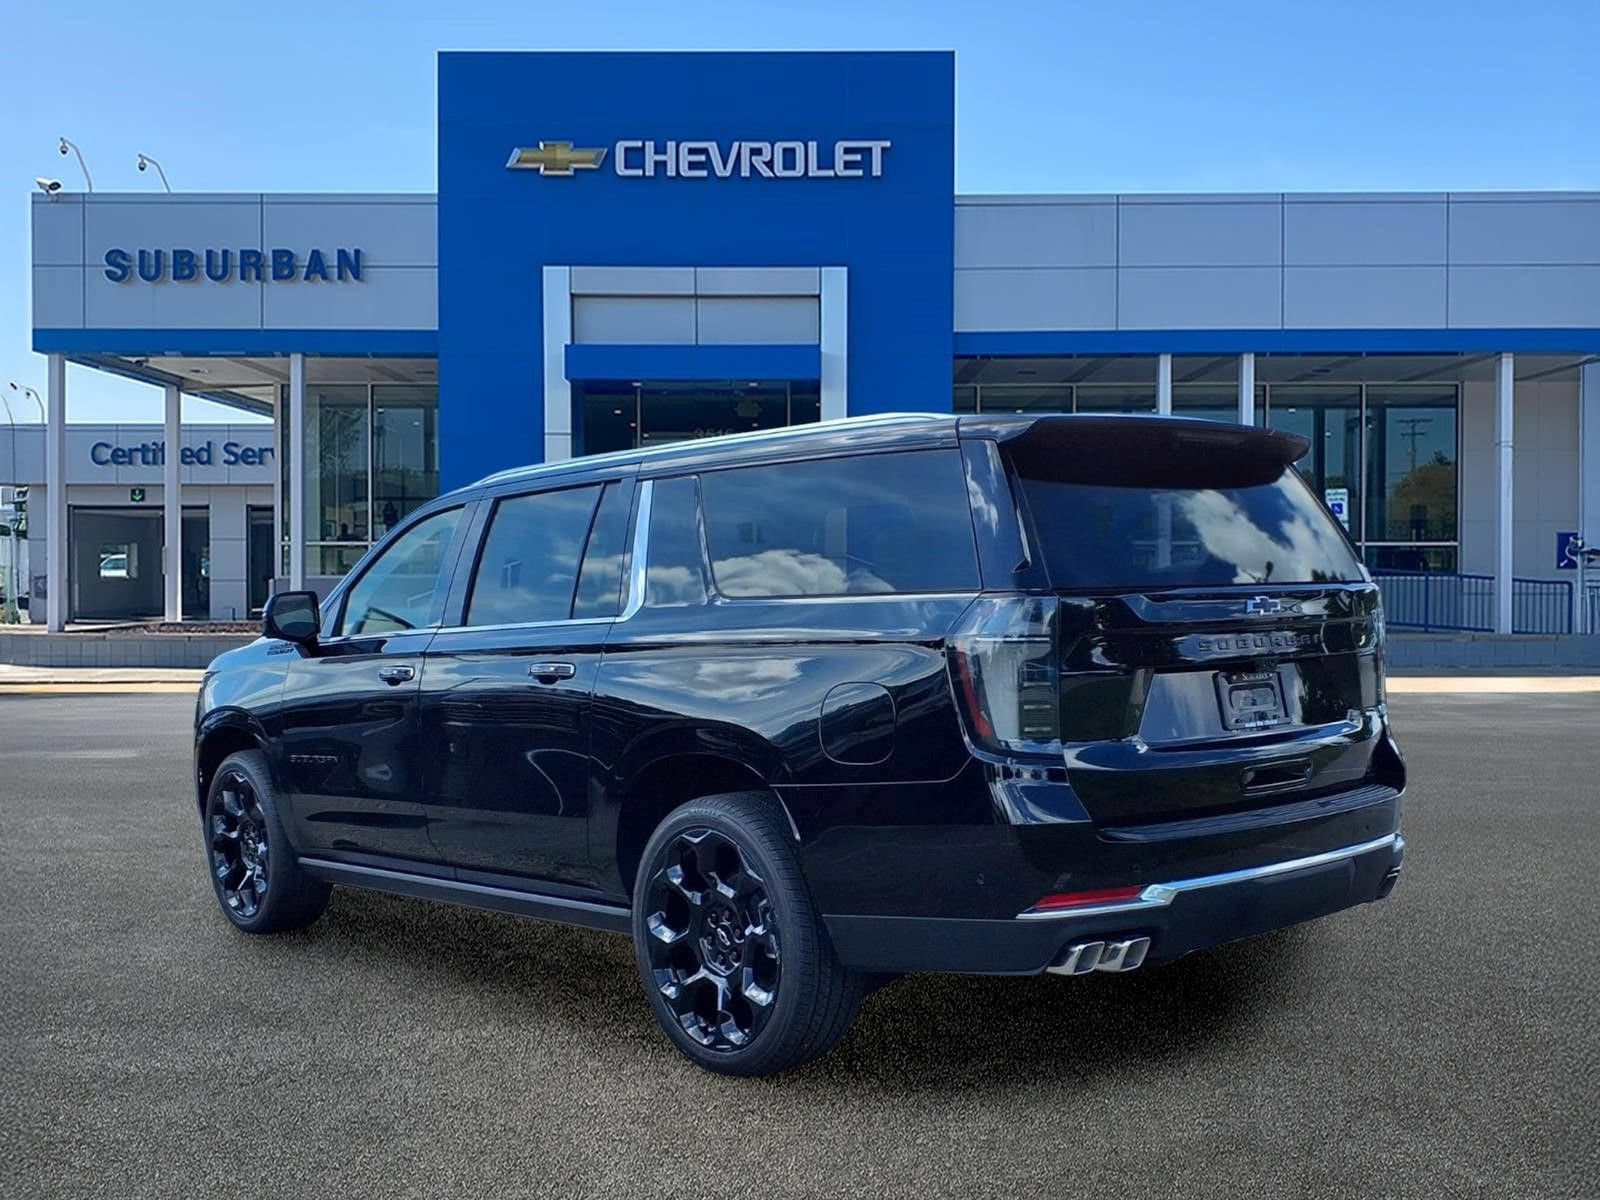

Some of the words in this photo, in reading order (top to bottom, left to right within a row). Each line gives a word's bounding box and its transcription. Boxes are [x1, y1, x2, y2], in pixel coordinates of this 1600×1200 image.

[614, 140, 892, 178] CHEVROLET
[104, 248, 363, 283] SUBURBAN
[91, 440, 213, 466] Certifed
